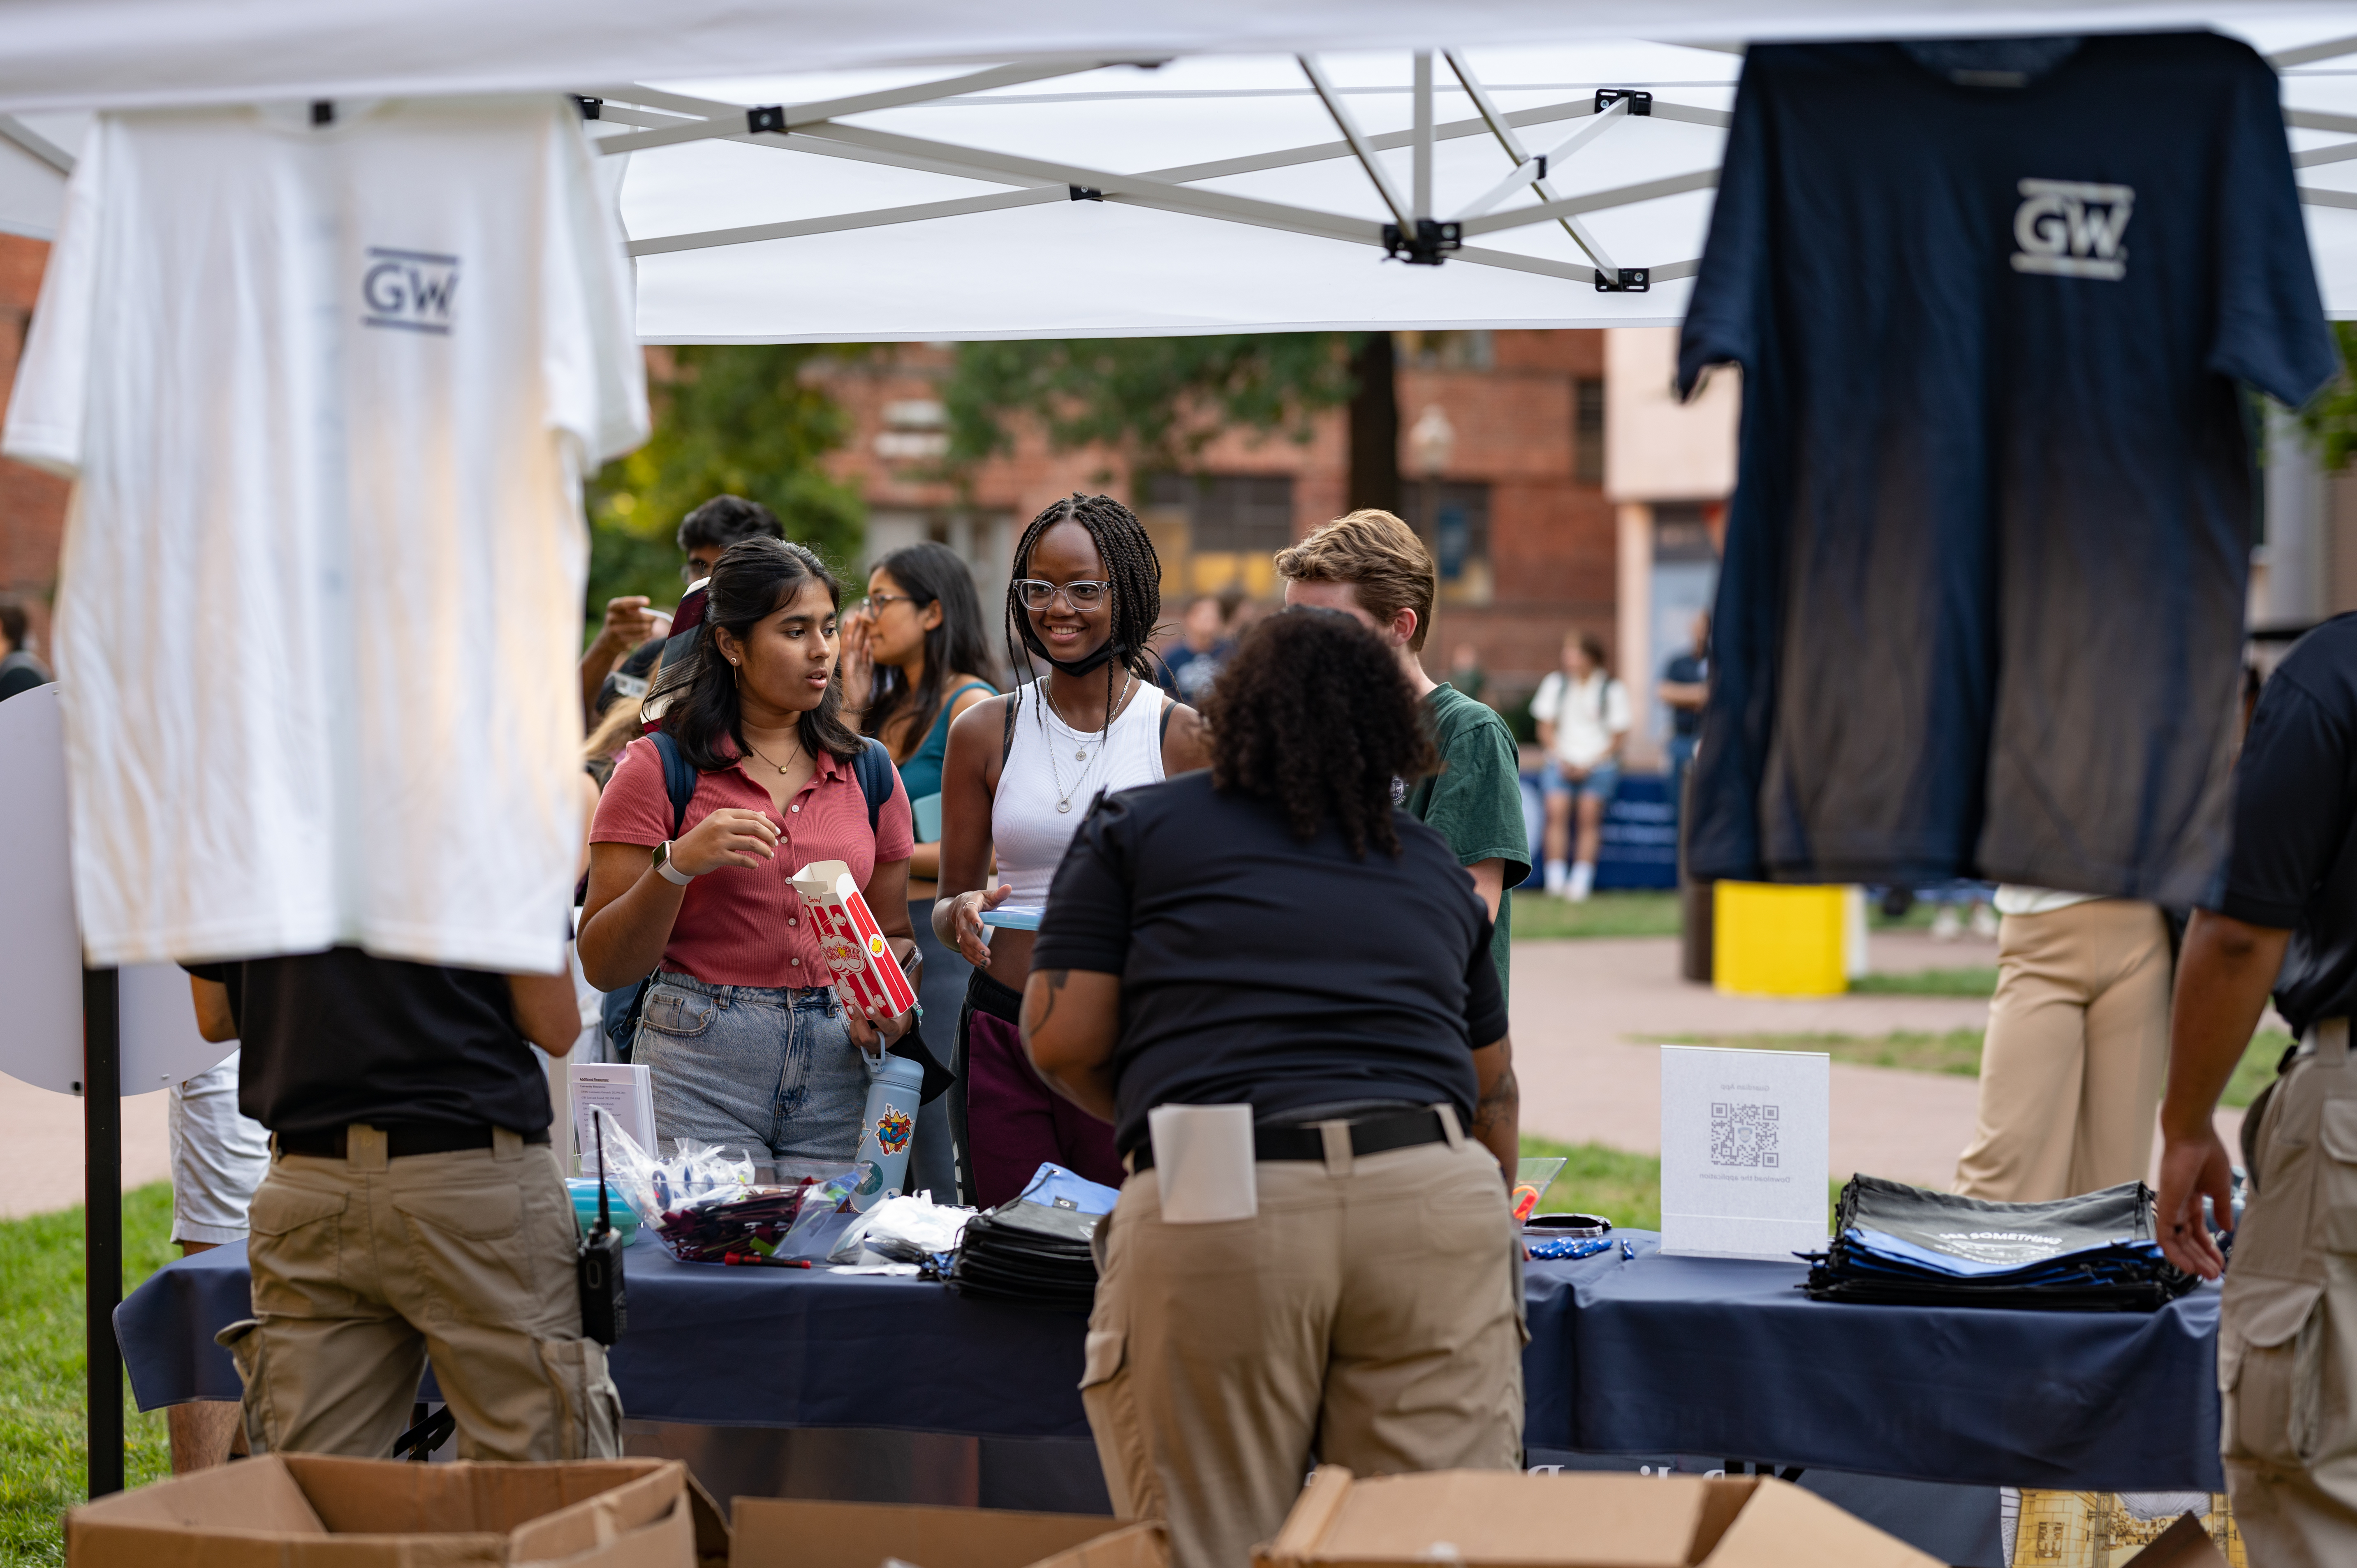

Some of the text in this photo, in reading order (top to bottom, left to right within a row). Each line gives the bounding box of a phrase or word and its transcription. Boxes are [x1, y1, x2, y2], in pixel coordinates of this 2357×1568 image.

[2014, 194, 2133, 258] GW
[362, 261, 459, 318] GW
[1394, 795, 1406, 805] LINKS
[808, 896, 822, 904] Enjoy!
[864, 1179, 872, 1187] LIBRARY
[865, 1178, 877, 1189] CONGRESS
[1969, 1231, 2063, 1245] SOMETHING
